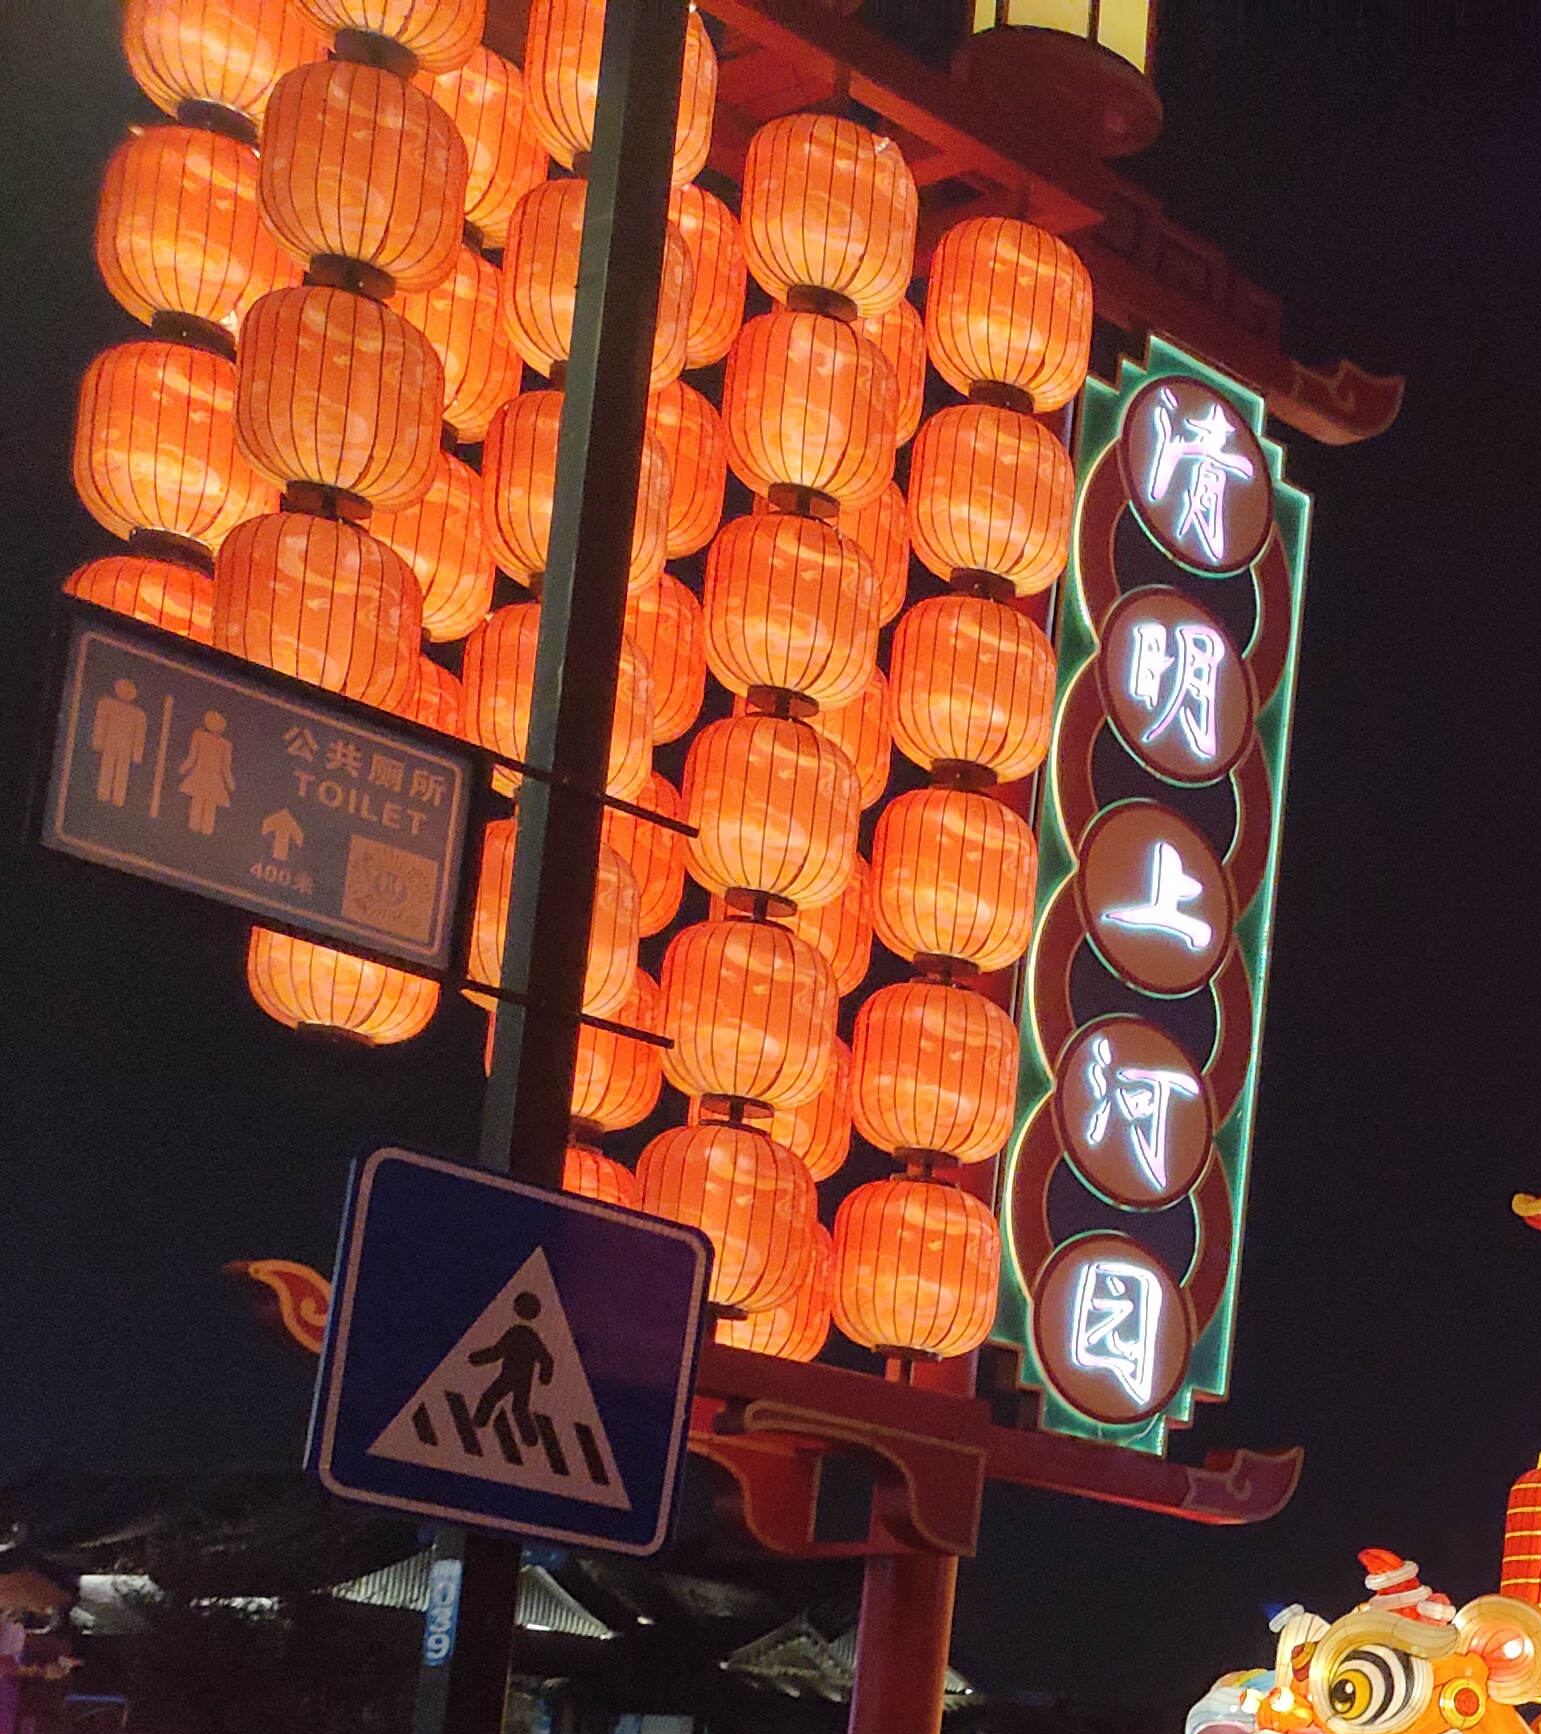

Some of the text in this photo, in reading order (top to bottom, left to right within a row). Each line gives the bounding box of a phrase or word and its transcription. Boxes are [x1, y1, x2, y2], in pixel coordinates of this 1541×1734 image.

[283, 725, 446, 807] 公共厕所
[293, 769, 428, 836] TOILET
[1071, 384, 1256, 1408] 清明上河园
